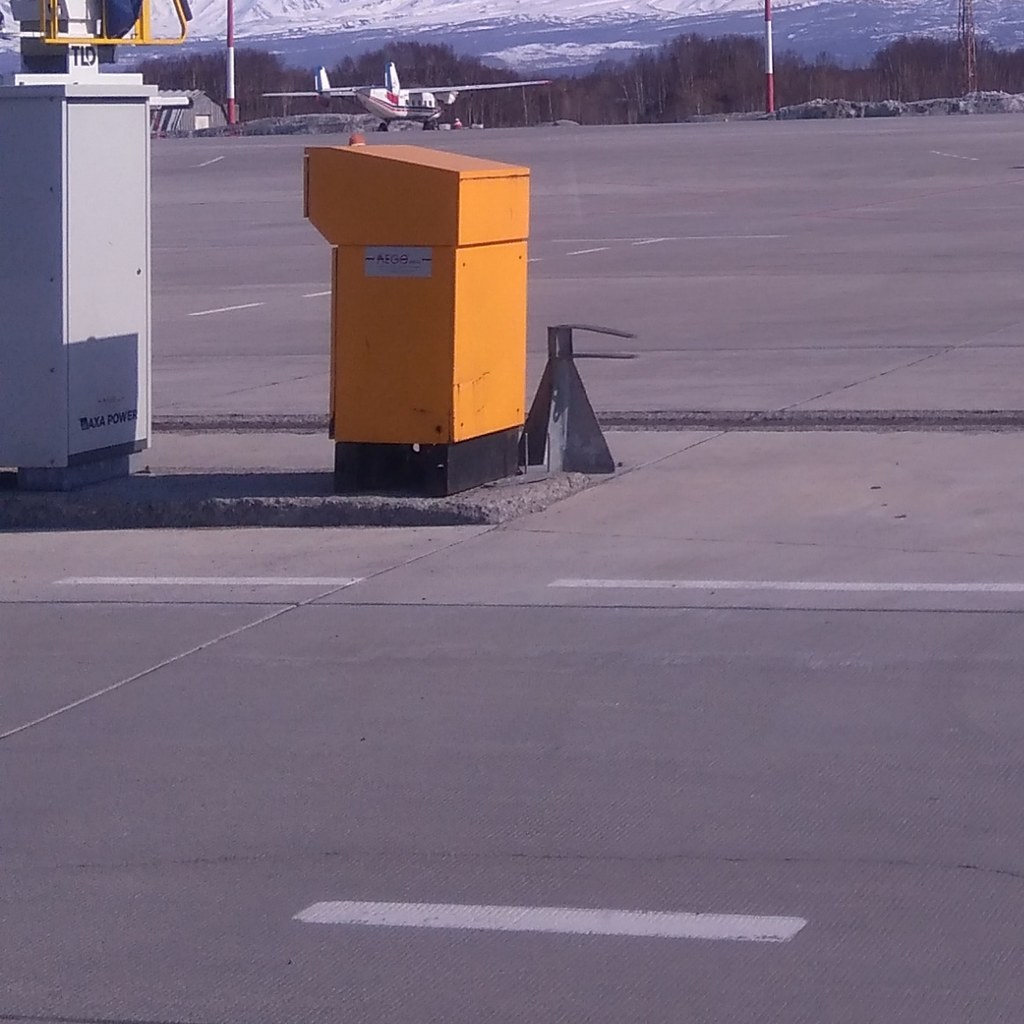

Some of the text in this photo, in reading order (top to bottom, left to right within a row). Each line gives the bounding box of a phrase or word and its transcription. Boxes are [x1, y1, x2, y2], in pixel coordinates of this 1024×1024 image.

[71, 46, 96, 66] TLD
[88, 409, 138, 428] AXA POWER
